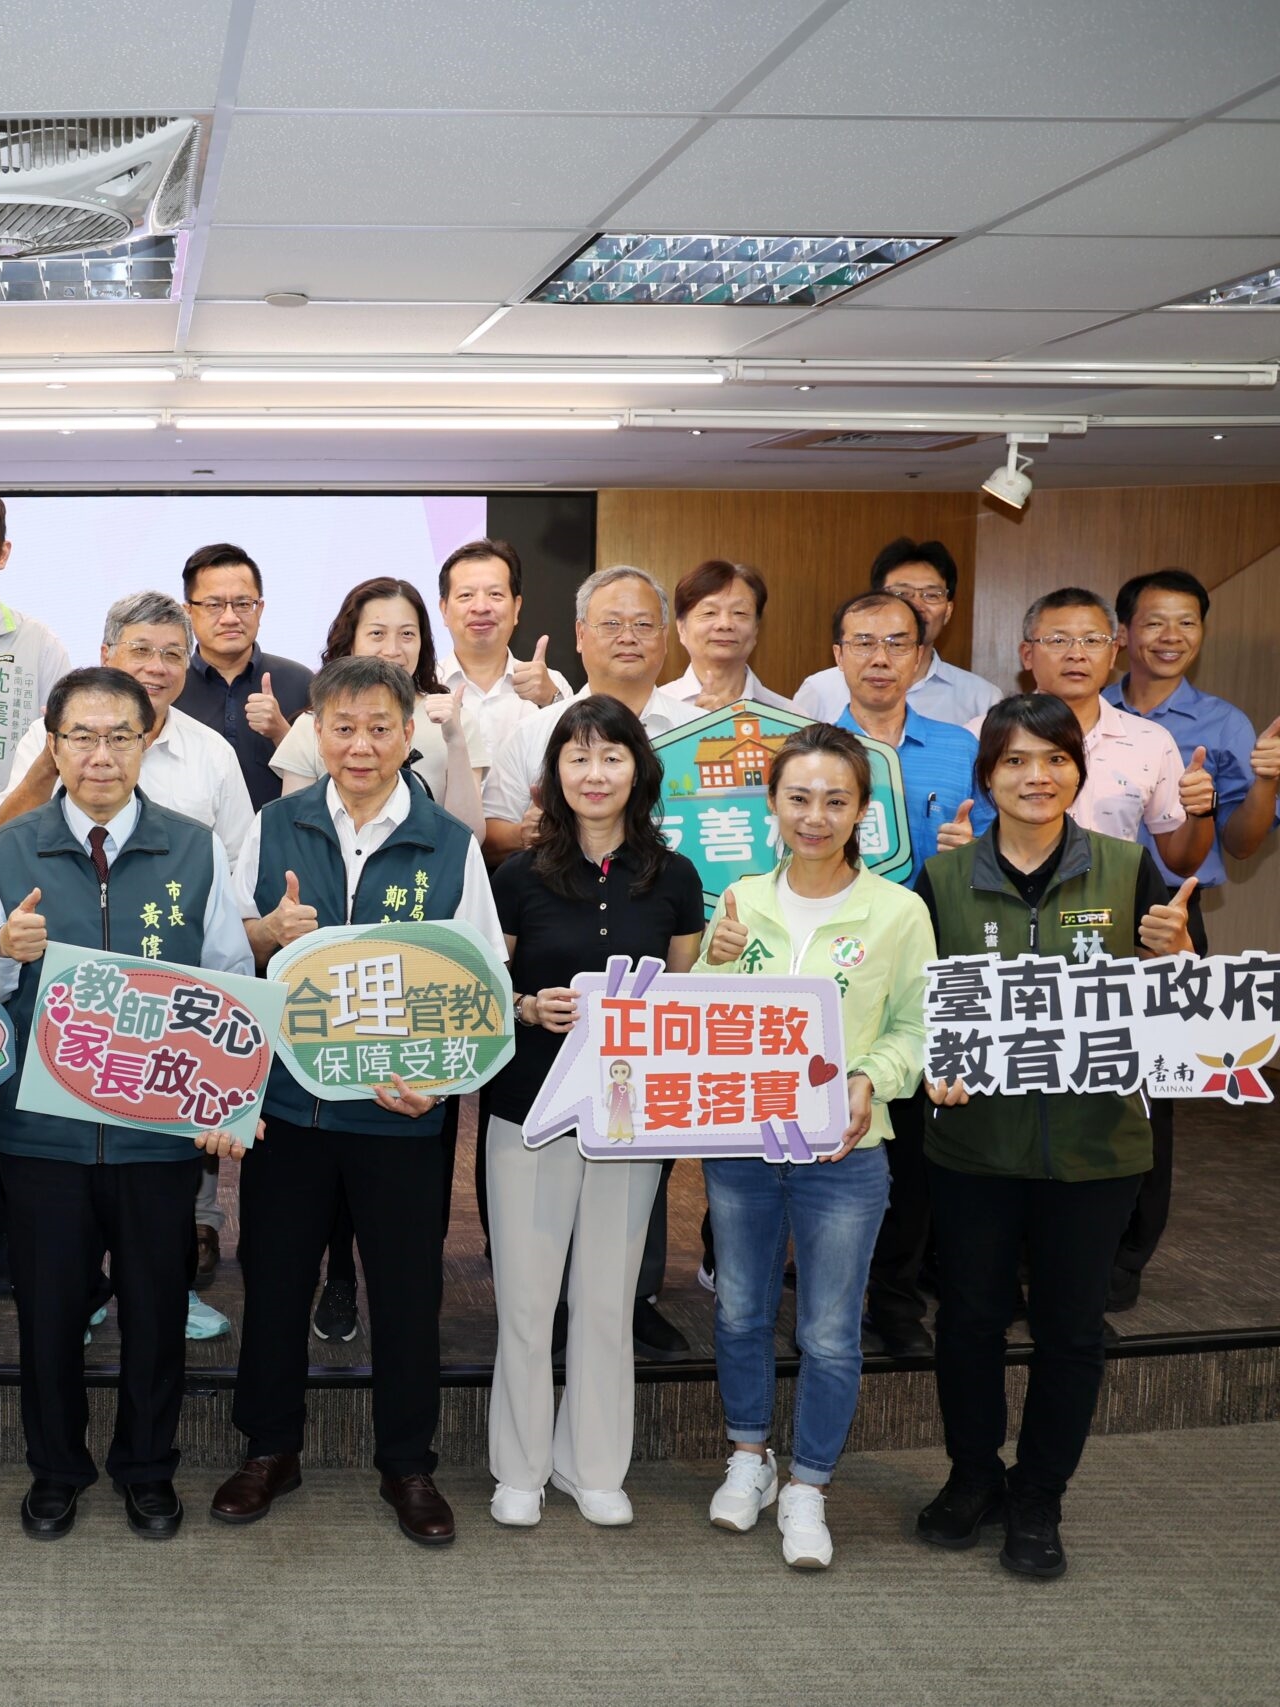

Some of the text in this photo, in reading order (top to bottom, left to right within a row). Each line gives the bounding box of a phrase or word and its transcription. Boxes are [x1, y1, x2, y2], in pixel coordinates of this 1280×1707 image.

[165, 880, 185, 927] 市長
[409, 869, 430, 922] 教育局
[1077, 914, 1109, 923] DPP
[140, 902, 163, 960] 黃偉
[1072, 930, 1104, 963] 林
[73, 963, 262, 1056] 教師安心
[286, 953, 496, 1037] 合理管教
[926, 957, 1280, 1023] 臺南市政府
[600, 998, 809, 1057] 正向管教
[58, 1023, 230, 1126] 家長放心
[313, 1035, 481, 1083] 保障受教
[928, 1026, 1140, 1091] 教育局
[1148, 1054, 1195, 1083] 臺南
[644, 1069, 800, 1131] 要落實
[1154, 1085, 1193, 1093] TAINAN
